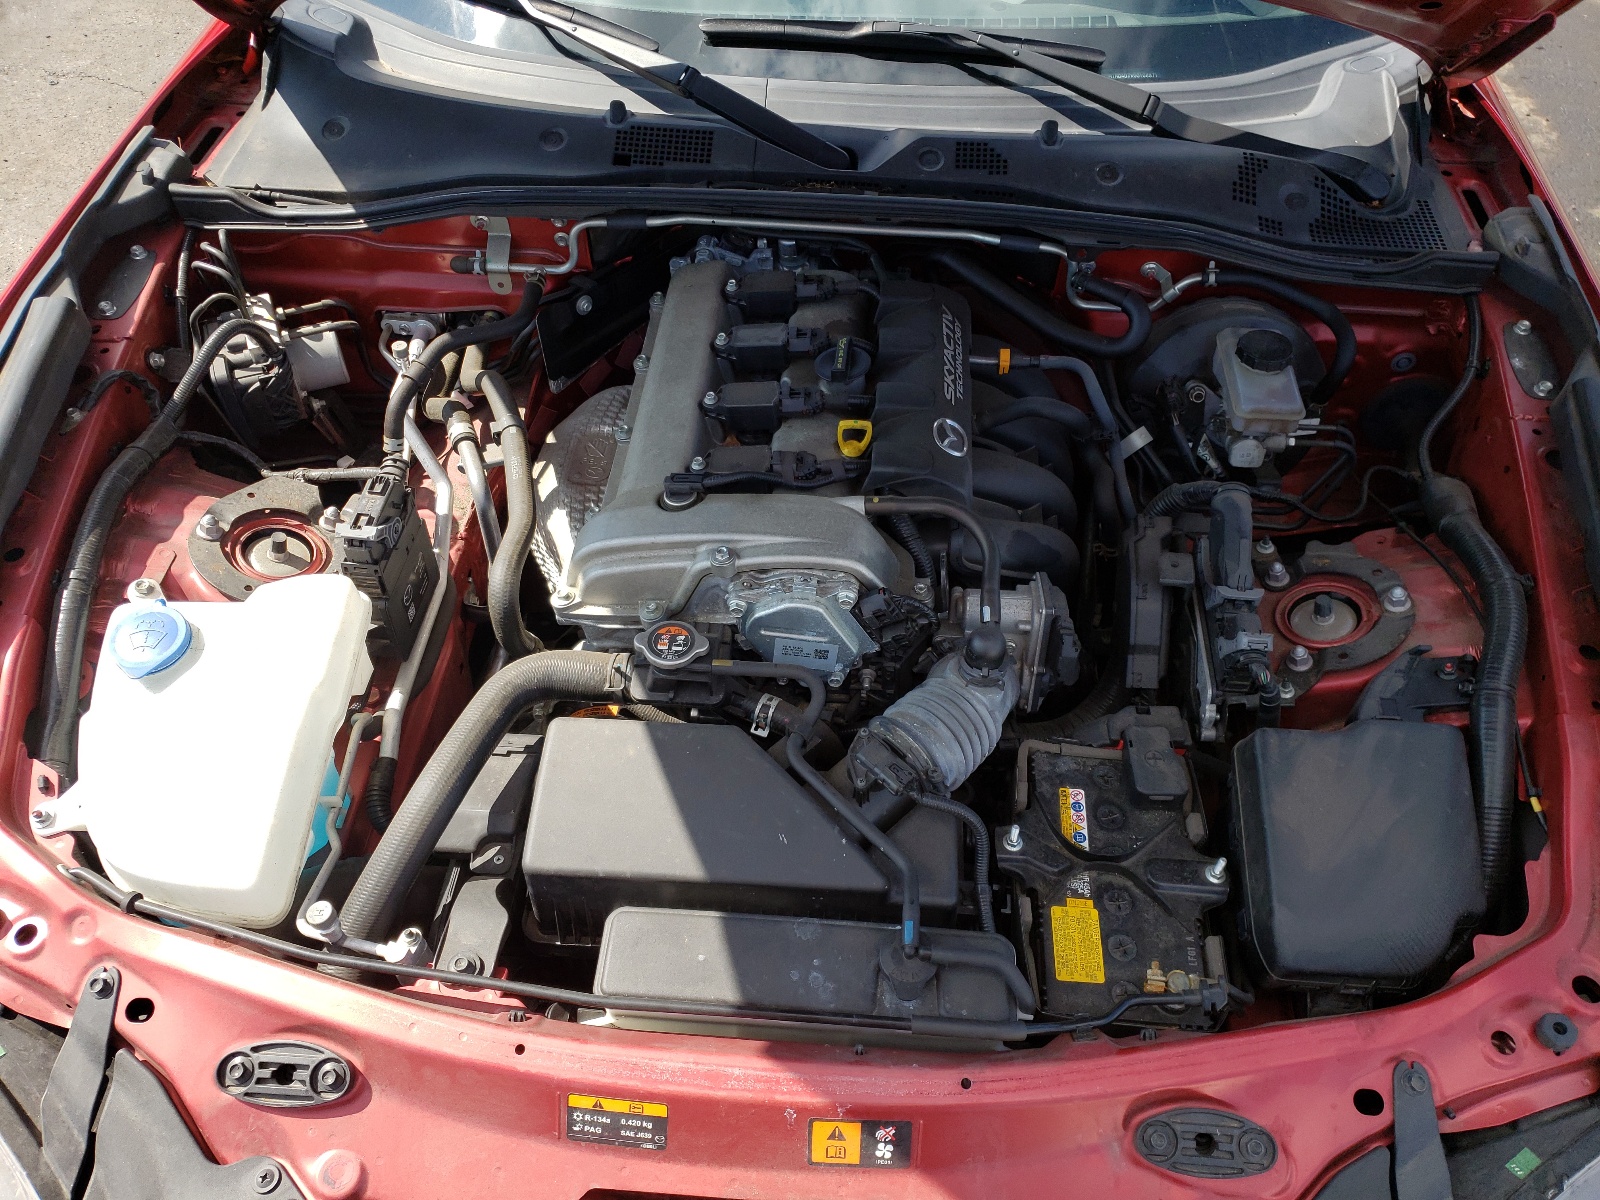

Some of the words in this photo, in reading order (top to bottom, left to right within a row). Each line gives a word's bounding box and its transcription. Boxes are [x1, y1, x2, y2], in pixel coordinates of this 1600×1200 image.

[942, 304, 954, 405] SKYACTIV
[954, 317, 963, 400] TECHNOLOGY
[584, 1114, 611, 1124] R-134a
[620, 1118, 641, 1127] 0.420
[642, 1120, 653, 1129] kg
[584, 1126, 602, 1134] PAG
